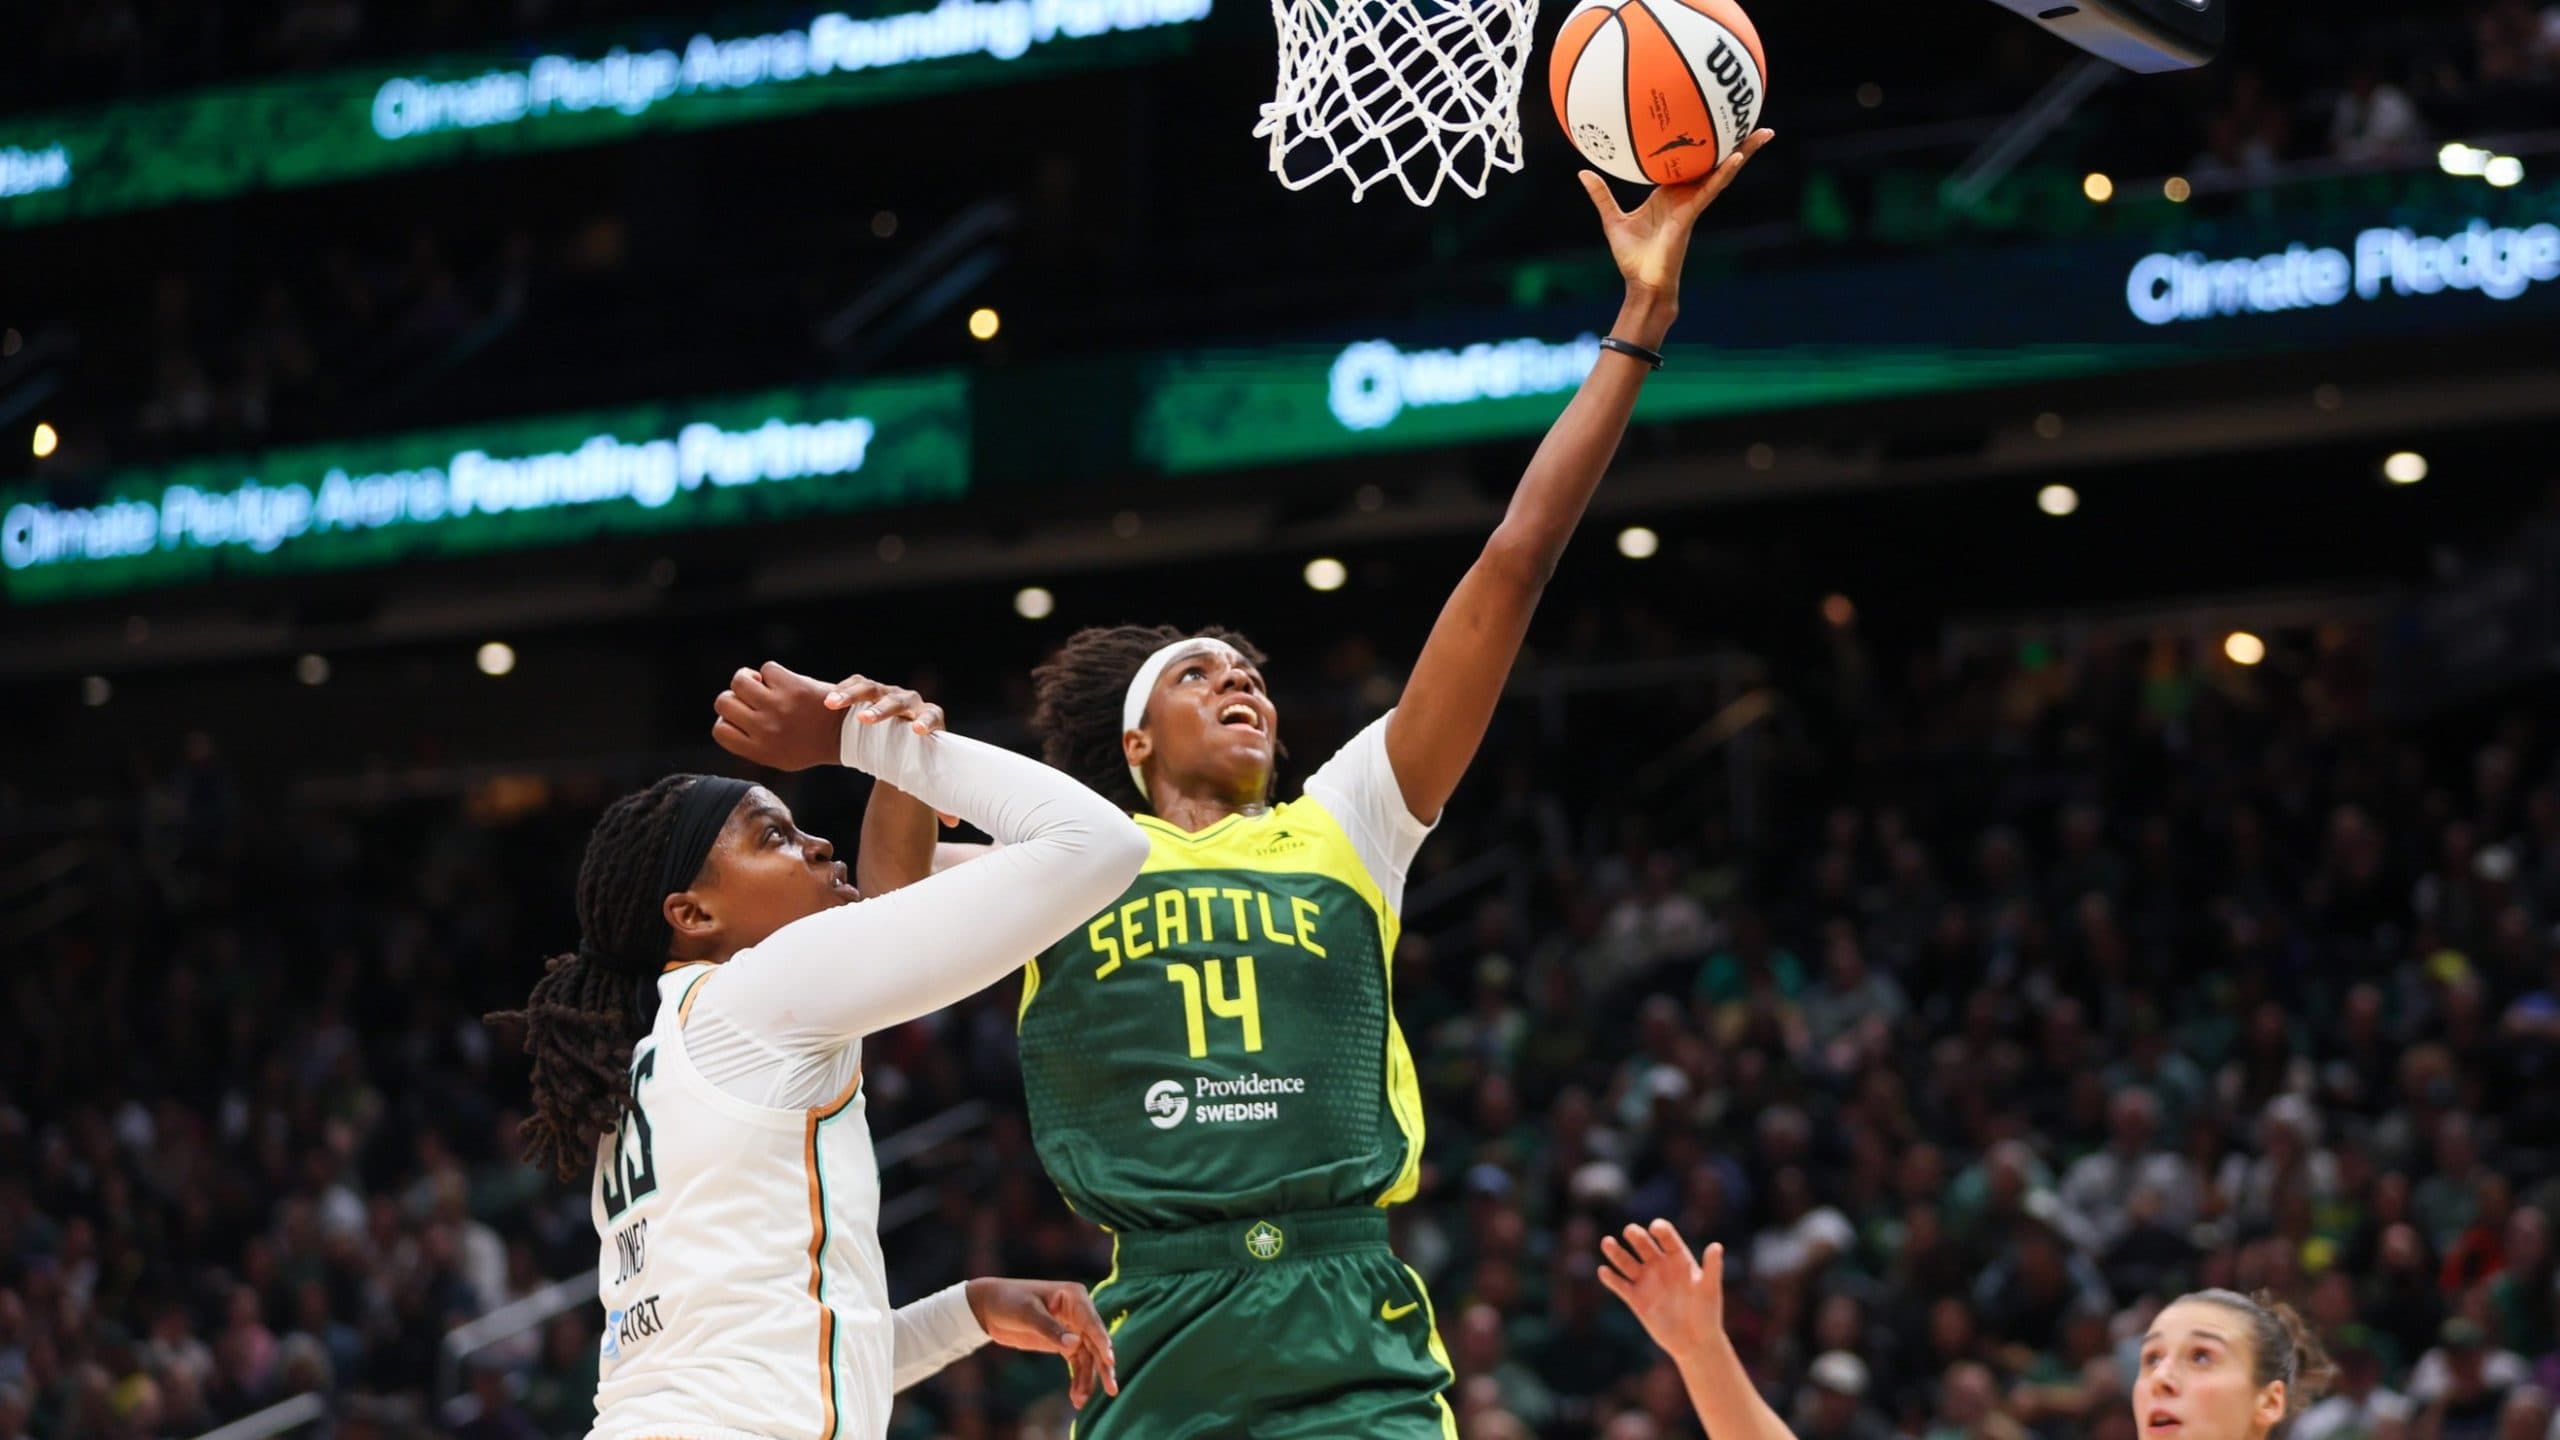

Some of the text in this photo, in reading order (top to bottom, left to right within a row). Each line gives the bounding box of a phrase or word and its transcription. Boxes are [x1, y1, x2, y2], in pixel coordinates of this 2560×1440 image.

[1706, 36, 1754, 151] Wilso
[2127, 217, 2560, 325] Climate Pledge
[1088, 887, 1328, 981] SEATTLE
[1166, 955, 1264, 1059] 14
[1195, 1073, 1305, 1097] Providence
[1195, 1102, 1279, 1123] SWEDISH
[620, 1294, 664, 1345] AT&T
